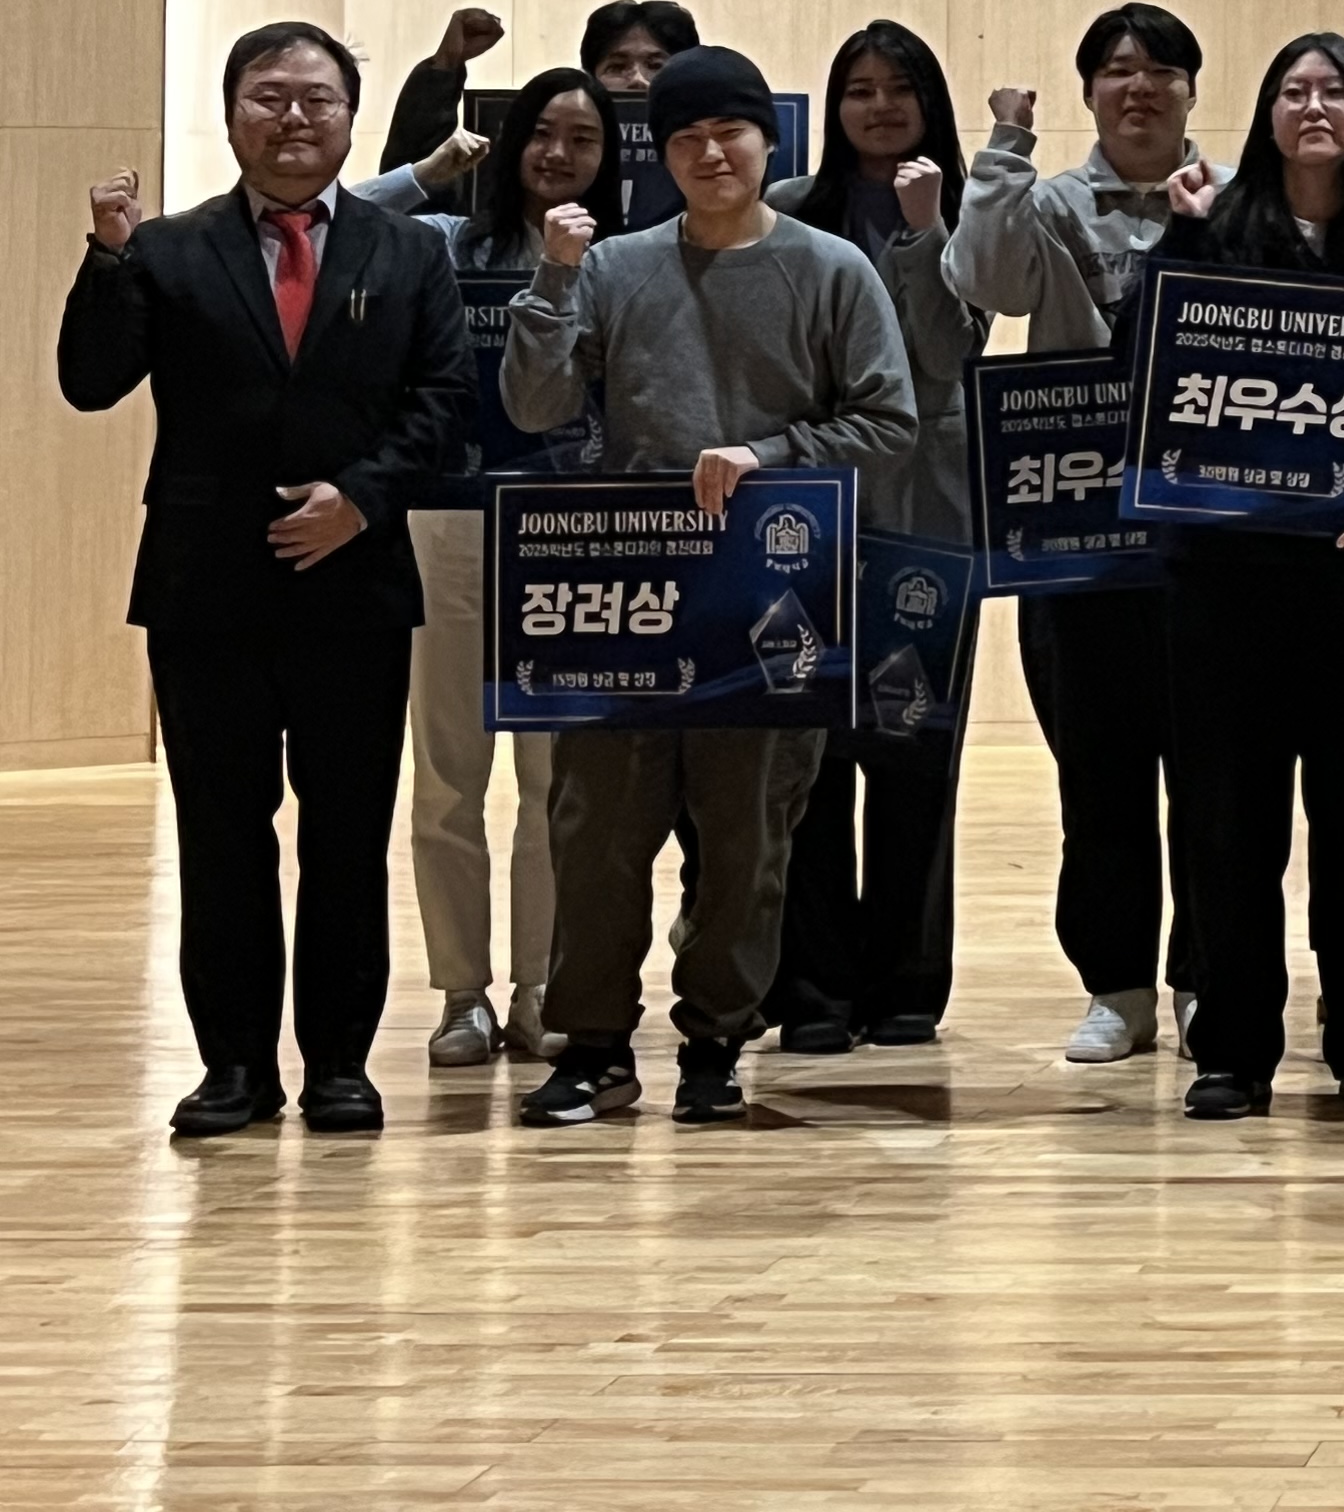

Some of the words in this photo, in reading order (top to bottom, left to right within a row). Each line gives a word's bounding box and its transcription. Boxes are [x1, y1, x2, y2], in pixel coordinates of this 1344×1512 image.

[1177, 302, 1274, 330] JOONGBU
[1000, 384, 1090, 412] JOONGBU
[1006, 451, 1126, 505] 최우
[518, 512, 609, 534] JOONGBU
[614, 510, 729, 532] UNIVERSITY
[521, 581, 680, 635] 장려상
